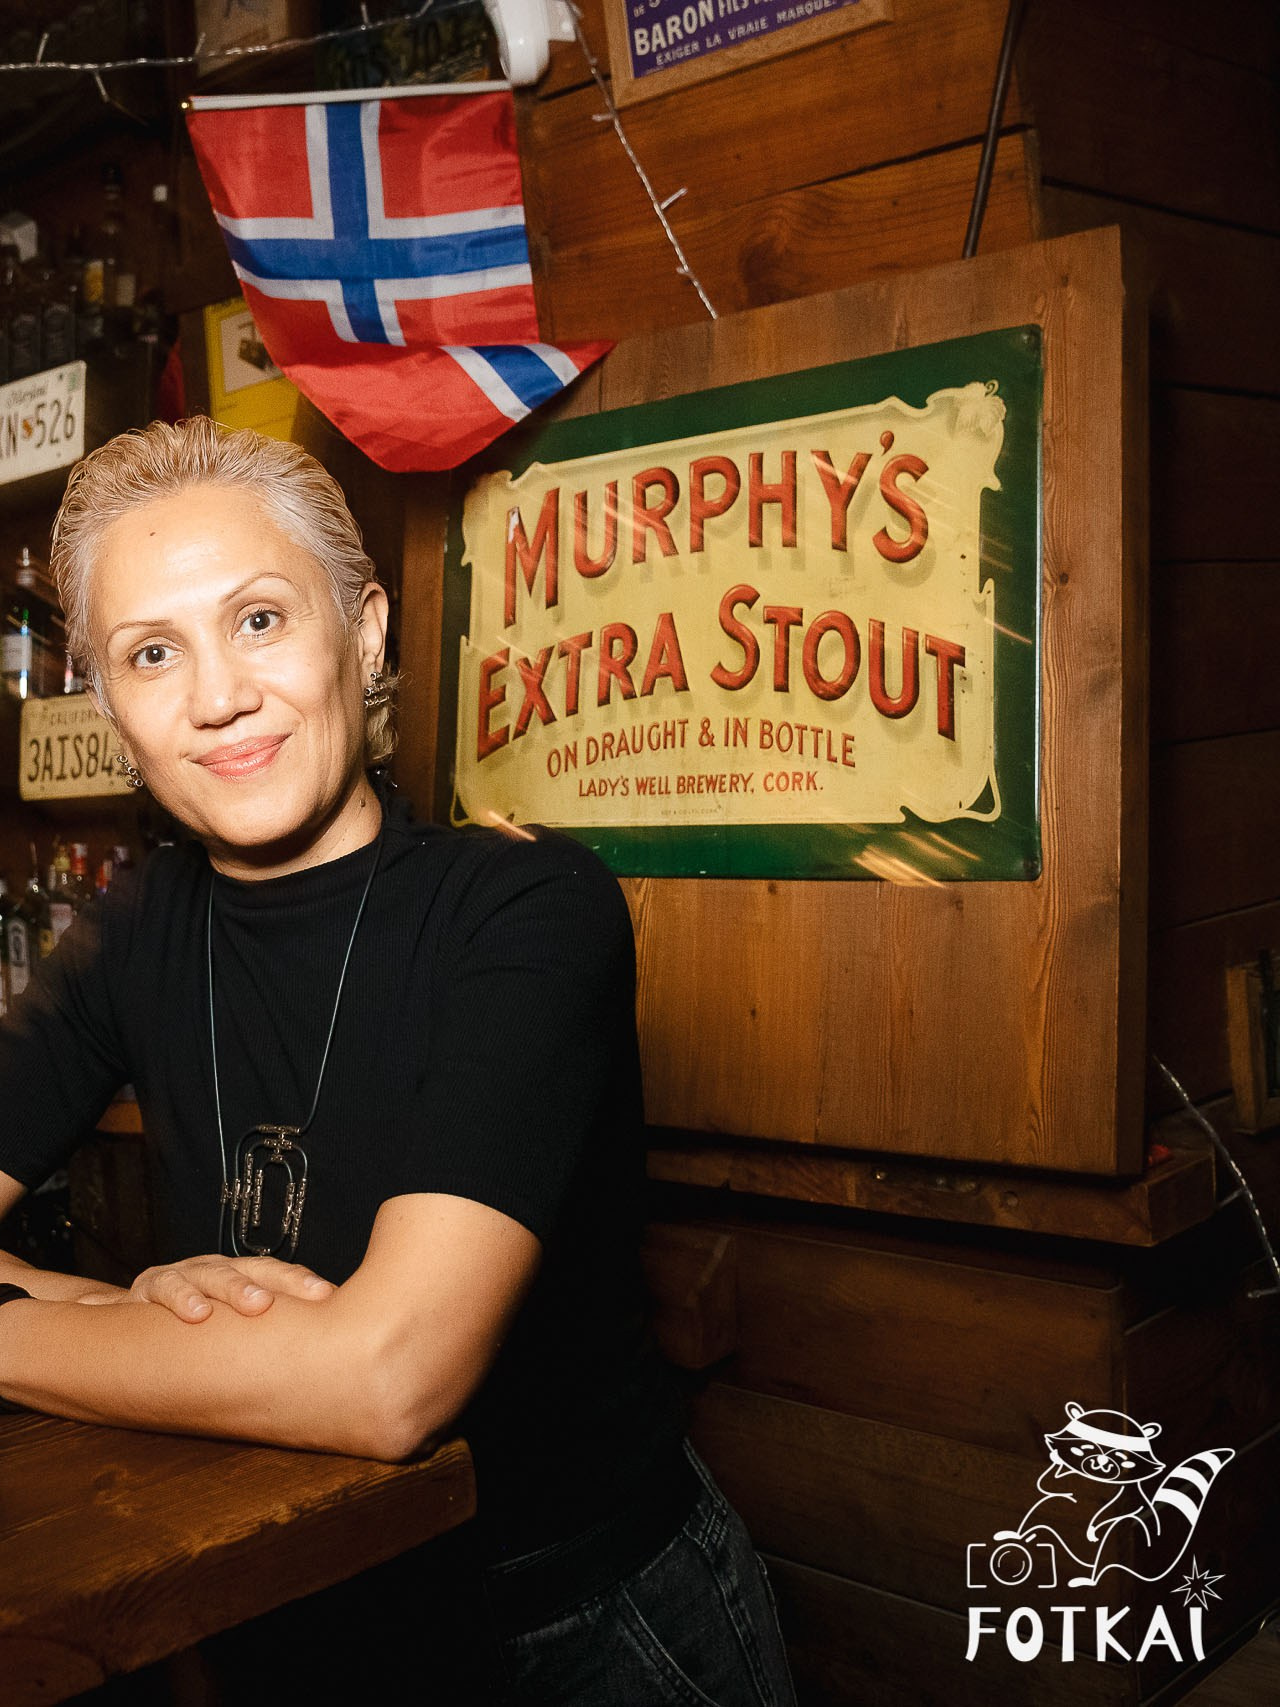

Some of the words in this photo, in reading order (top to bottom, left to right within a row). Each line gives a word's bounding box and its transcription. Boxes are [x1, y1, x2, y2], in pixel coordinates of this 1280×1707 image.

[634, 0, 714, 56] BARON
[655, 41, 700, 66] EXIGER
[705, 33, 722, 48] LA
[727, 16, 768, 40] VRAIE
[34, 399, 75, 450] 526
[504, 430, 929, 629] MURPHY'S
[477, 612, 690, 762] EXTRA
[710, 584, 966, 742] STOUT
[28, 731, 121, 783] 3AIS84
[546, 741, 578, 778] ON
[585, 718, 689, 766] DRAUGHT
[698, 717, 715, 747] &
[723, 717, 751, 748] IN
[759, 719, 856, 768] BOTTLE
[578, 775, 629, 797] LADY'S
[635, 776, 671, 796] WELL
[763, 770, 824, 793] CORK.
